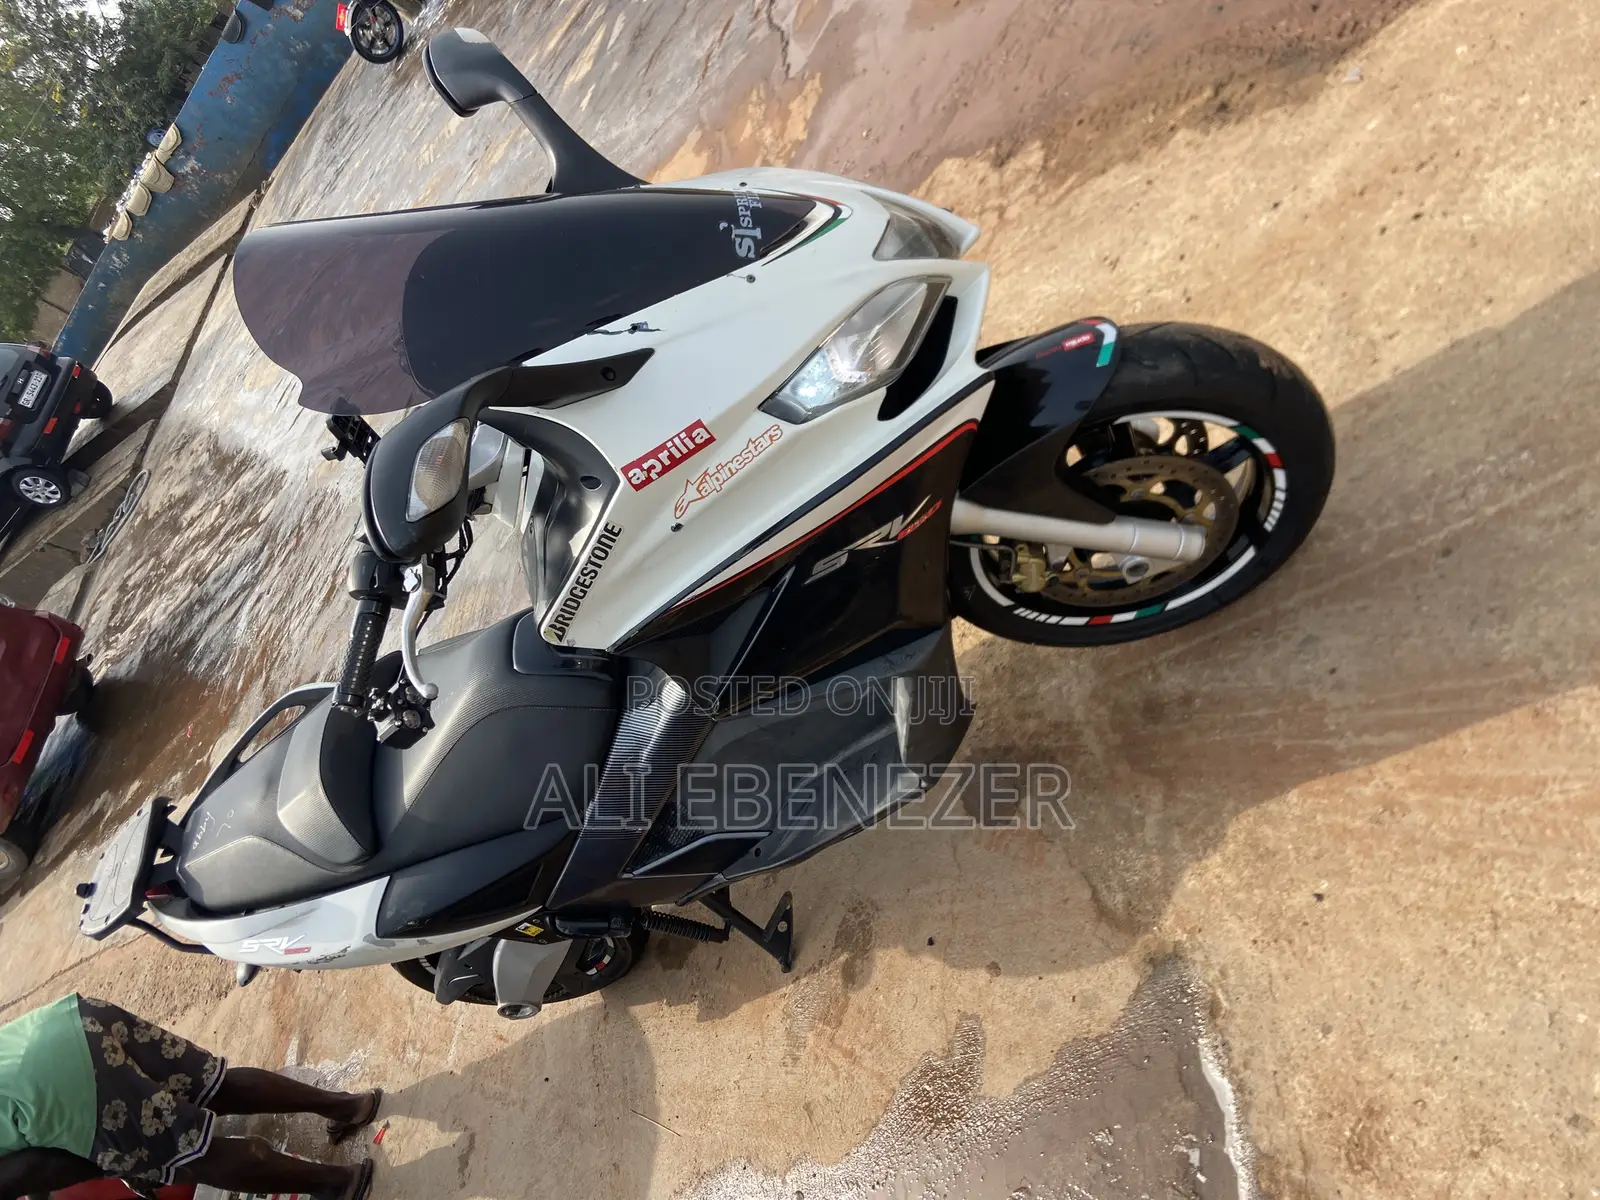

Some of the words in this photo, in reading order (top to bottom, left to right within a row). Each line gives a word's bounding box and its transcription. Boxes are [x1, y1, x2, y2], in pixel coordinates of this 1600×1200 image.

[627, 427, 711, 486] aprilia
[698, 424, 783, 493] alpinestars
[549, 522, 622, 642] BRIDGESTONE
